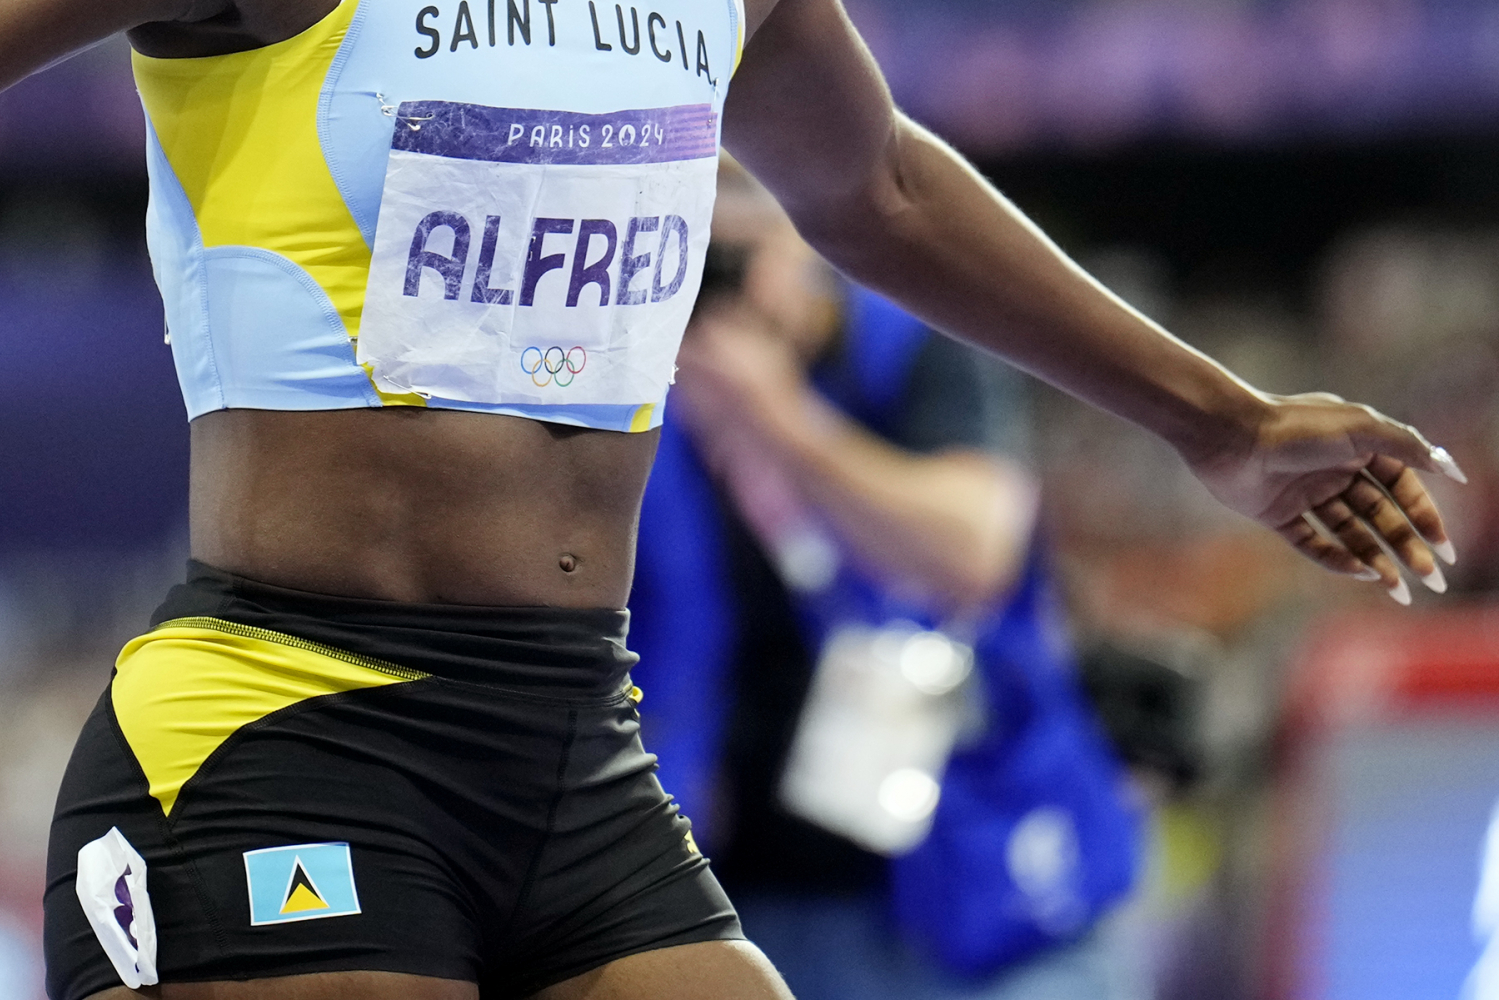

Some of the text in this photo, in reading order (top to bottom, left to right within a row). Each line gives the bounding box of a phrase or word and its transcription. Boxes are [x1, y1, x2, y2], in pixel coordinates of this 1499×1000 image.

[588, 0, 713, 86] LUCIA
[601, 124, 664, 148] 2024
[402, 210, 689, 308] ALFRED
